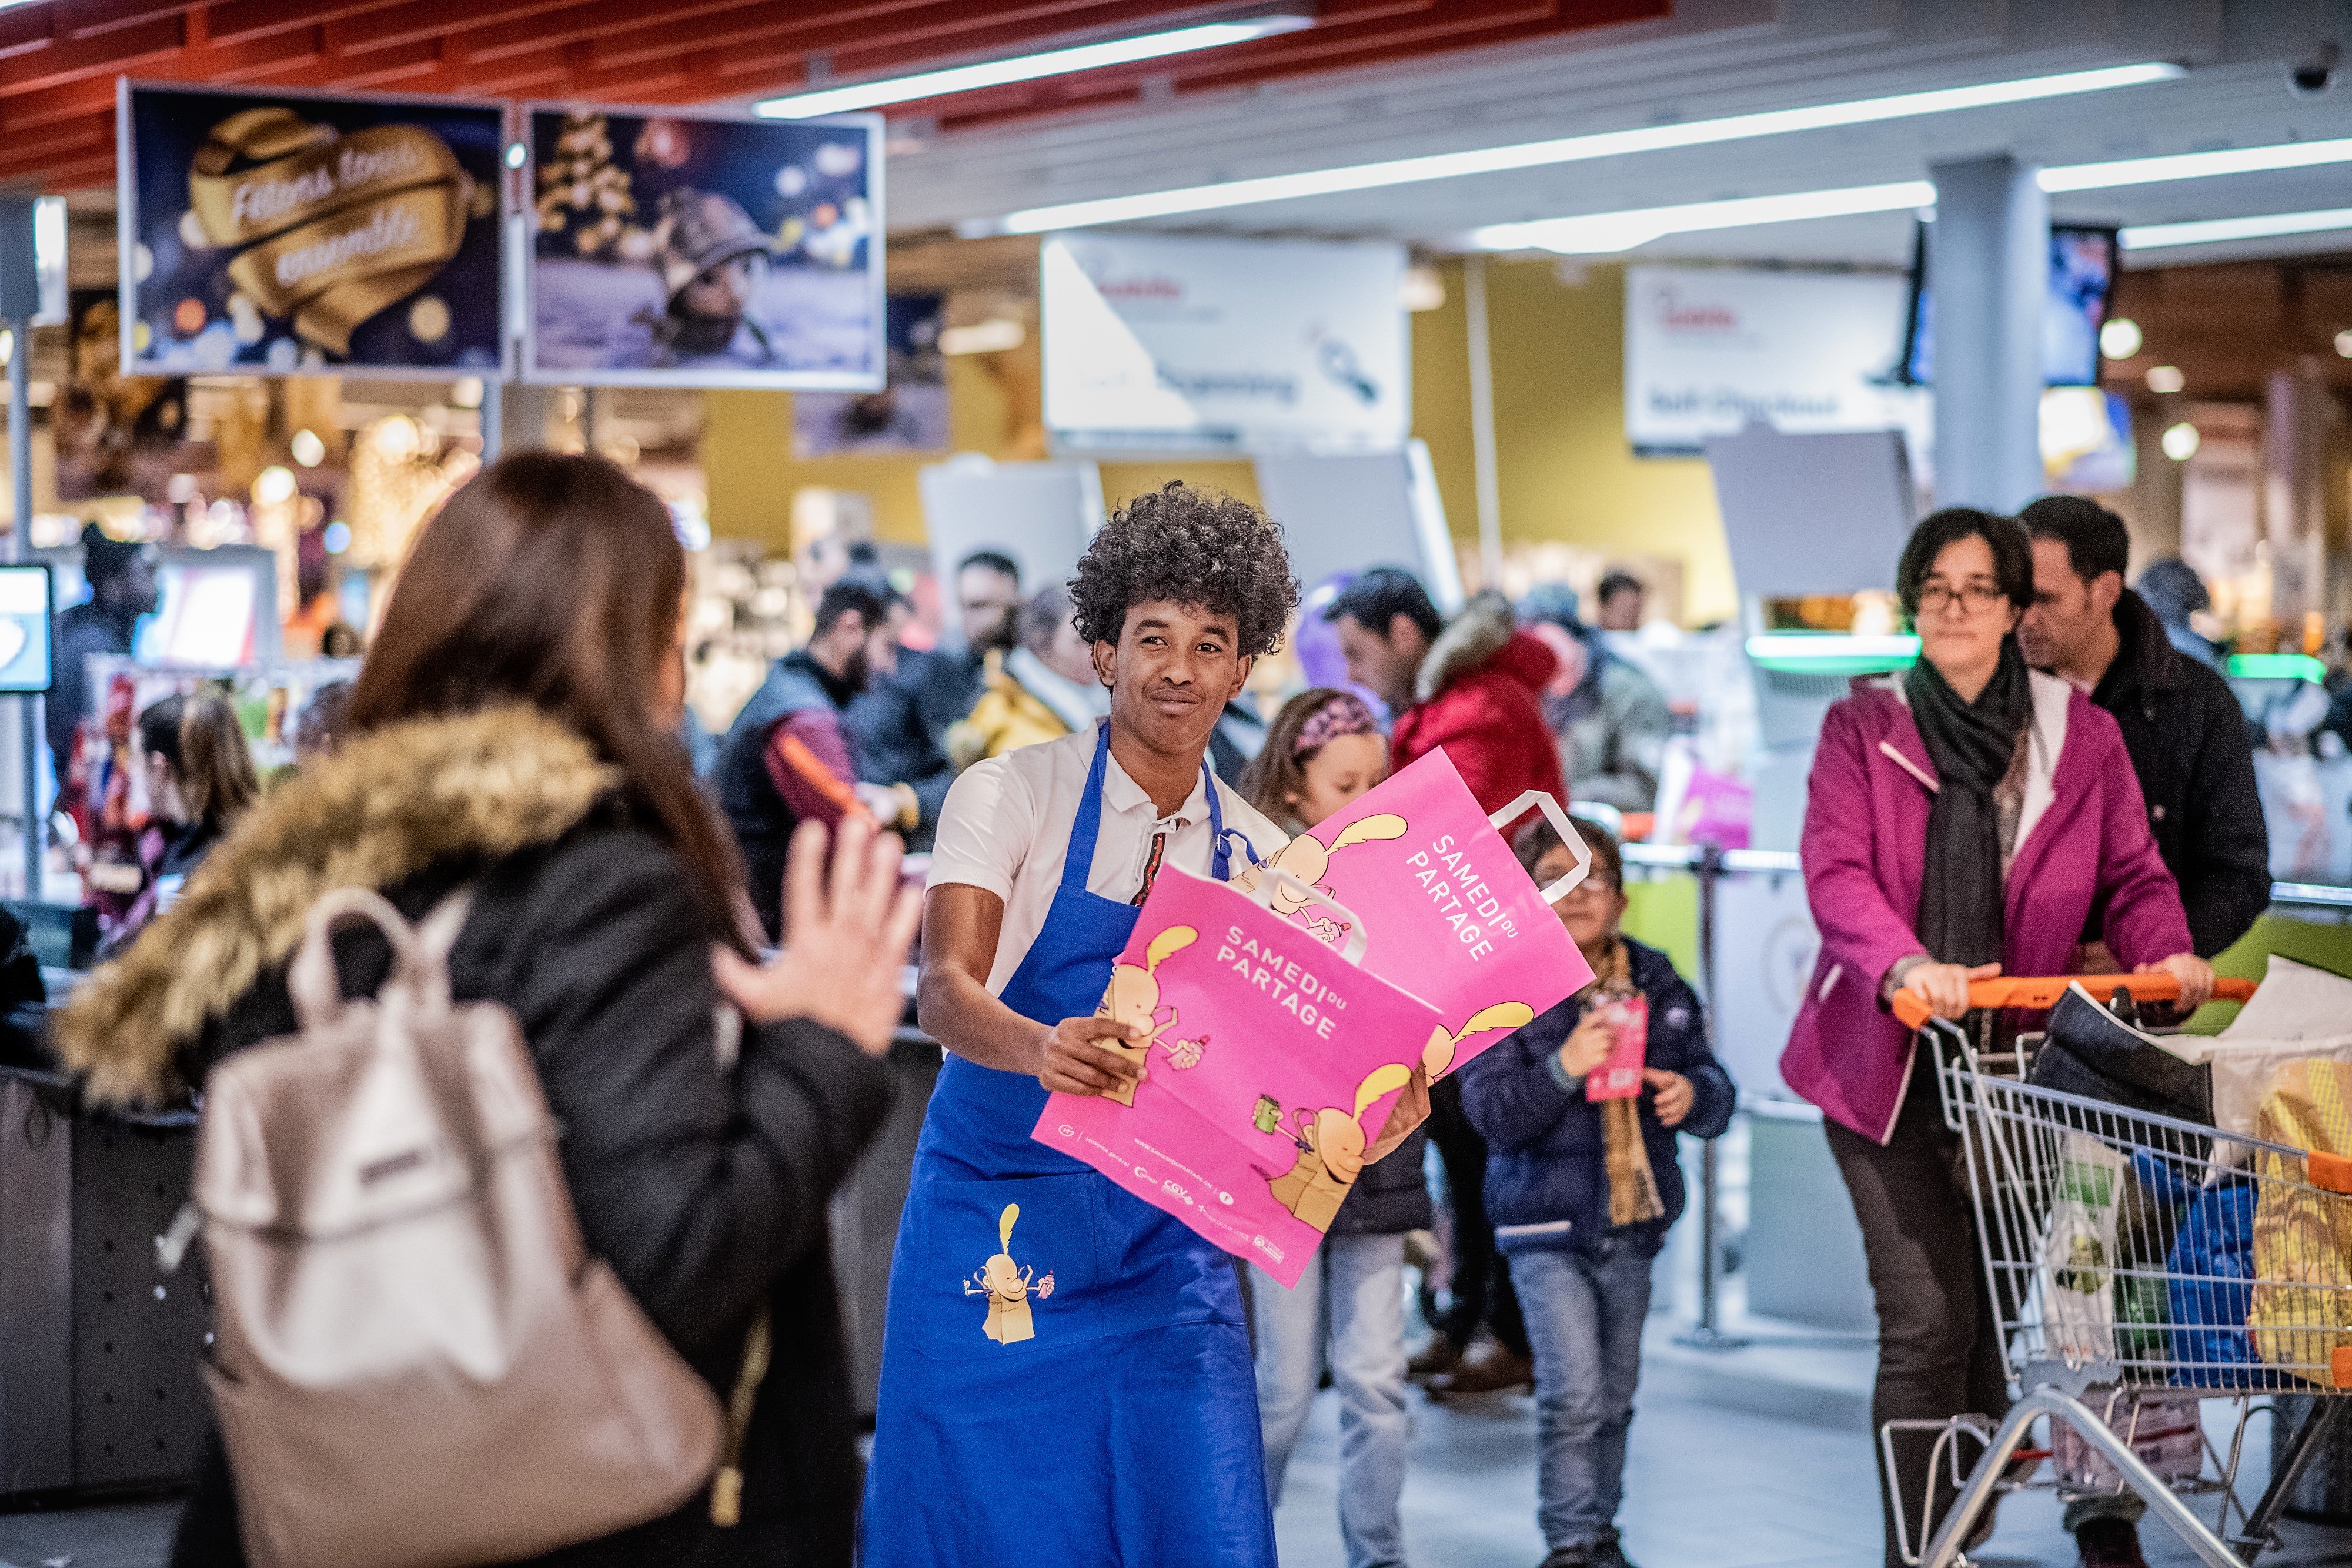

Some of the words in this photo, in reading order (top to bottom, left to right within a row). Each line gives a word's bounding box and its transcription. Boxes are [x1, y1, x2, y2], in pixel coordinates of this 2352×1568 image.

[1406, 851, 1494, 962] PARTAGE
[1432, 834, 1505, 930] SAMEDI
[1500, 919, 1519, 939] DU
[1216, 946, 1336, 1041] PARTAGE
[1225, 925, 1328, 1003] SAMEDI
[1325, 991, 1347, 1011] DU
